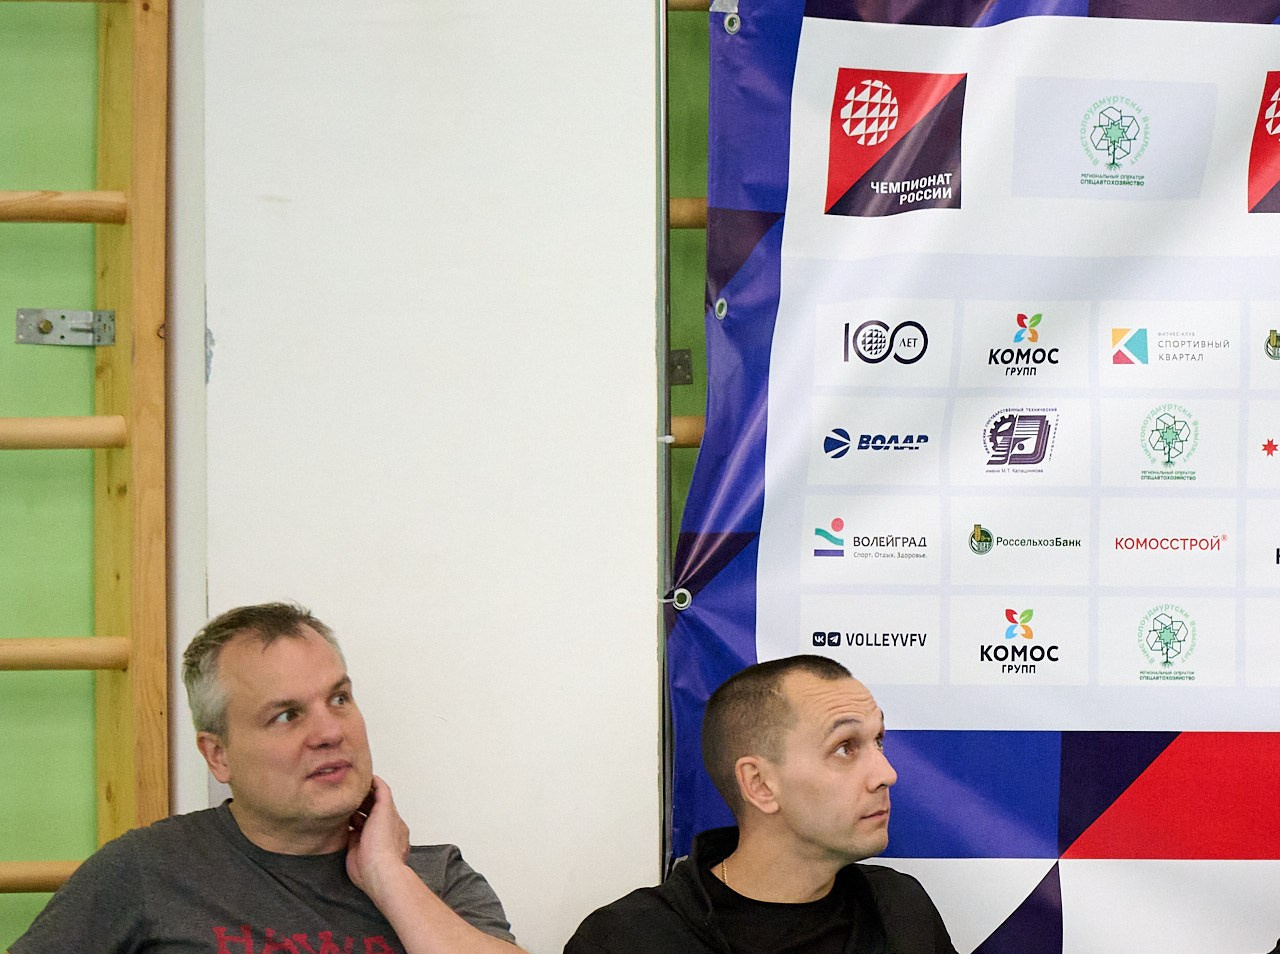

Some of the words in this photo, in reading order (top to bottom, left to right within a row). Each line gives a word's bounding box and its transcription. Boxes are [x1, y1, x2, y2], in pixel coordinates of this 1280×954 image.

[870, 173, 952, 195] ЧЕМПИОНАТ
[899, 187, 952, 206] РОССИИ
[1157, 339, 1230, 349] СПОРТИВНЫЙ
[988, 348, 1059, 365] КОМОС
[1158, 353, 1204, 361] КВАРТАЛ
[1005, 367, 1037, 376] ГРУПП
[853, 534, 927, 548] ВОЛЕЙГРАД
[996, 536, 1081, 547] РоссельхозБанк
[845, 632, 927, 647] VOLLEYVFV
[980, 645, 1059, 662] КОМОС
[1001, 664, 1036, 674] ГРУПП
